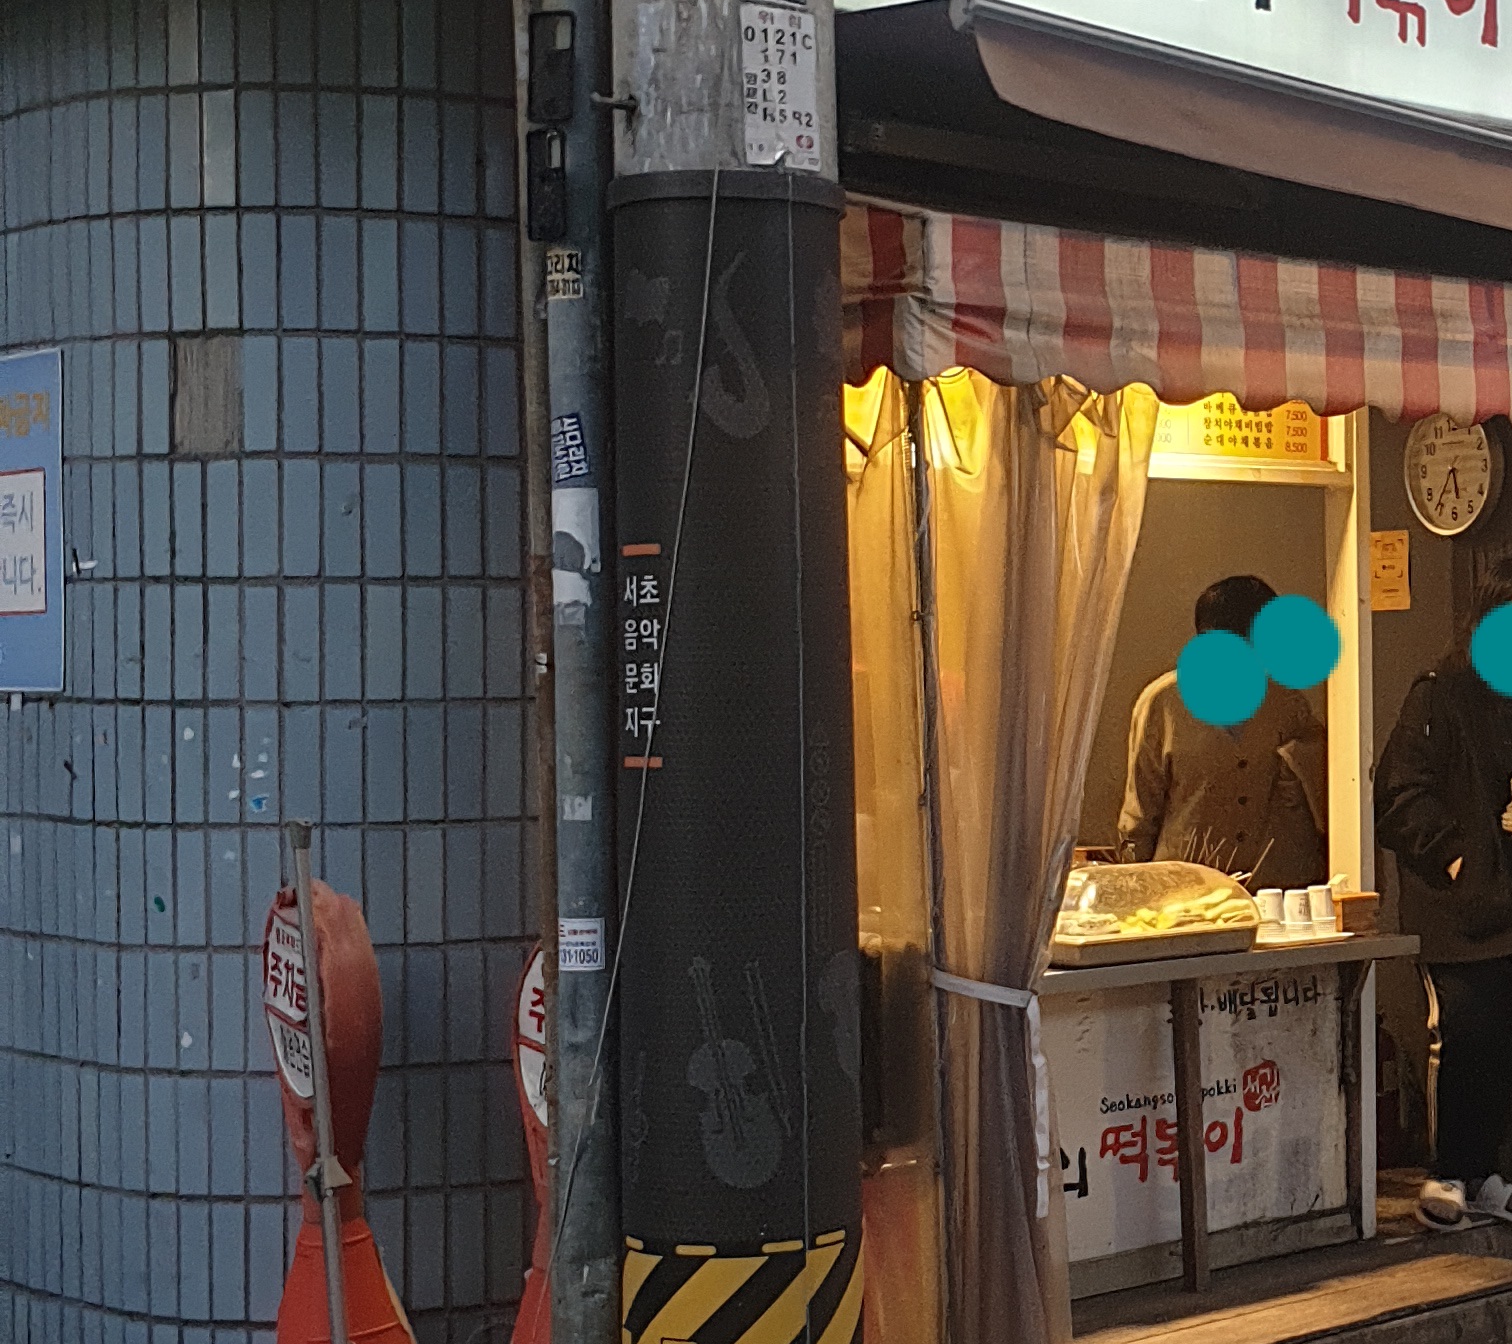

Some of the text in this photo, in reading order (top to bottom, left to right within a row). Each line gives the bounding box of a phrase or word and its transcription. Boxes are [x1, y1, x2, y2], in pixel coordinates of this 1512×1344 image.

[0, 553, 42, 596] 니다.
[624, 574, 660, 607] 서초
[624, 618, 661, 651] 음악
[624, 662, 660, 694] 문화
[625, 706, 661, 738] 지구
[1099, 1078, 1238, 1115] Seokangso pokki
